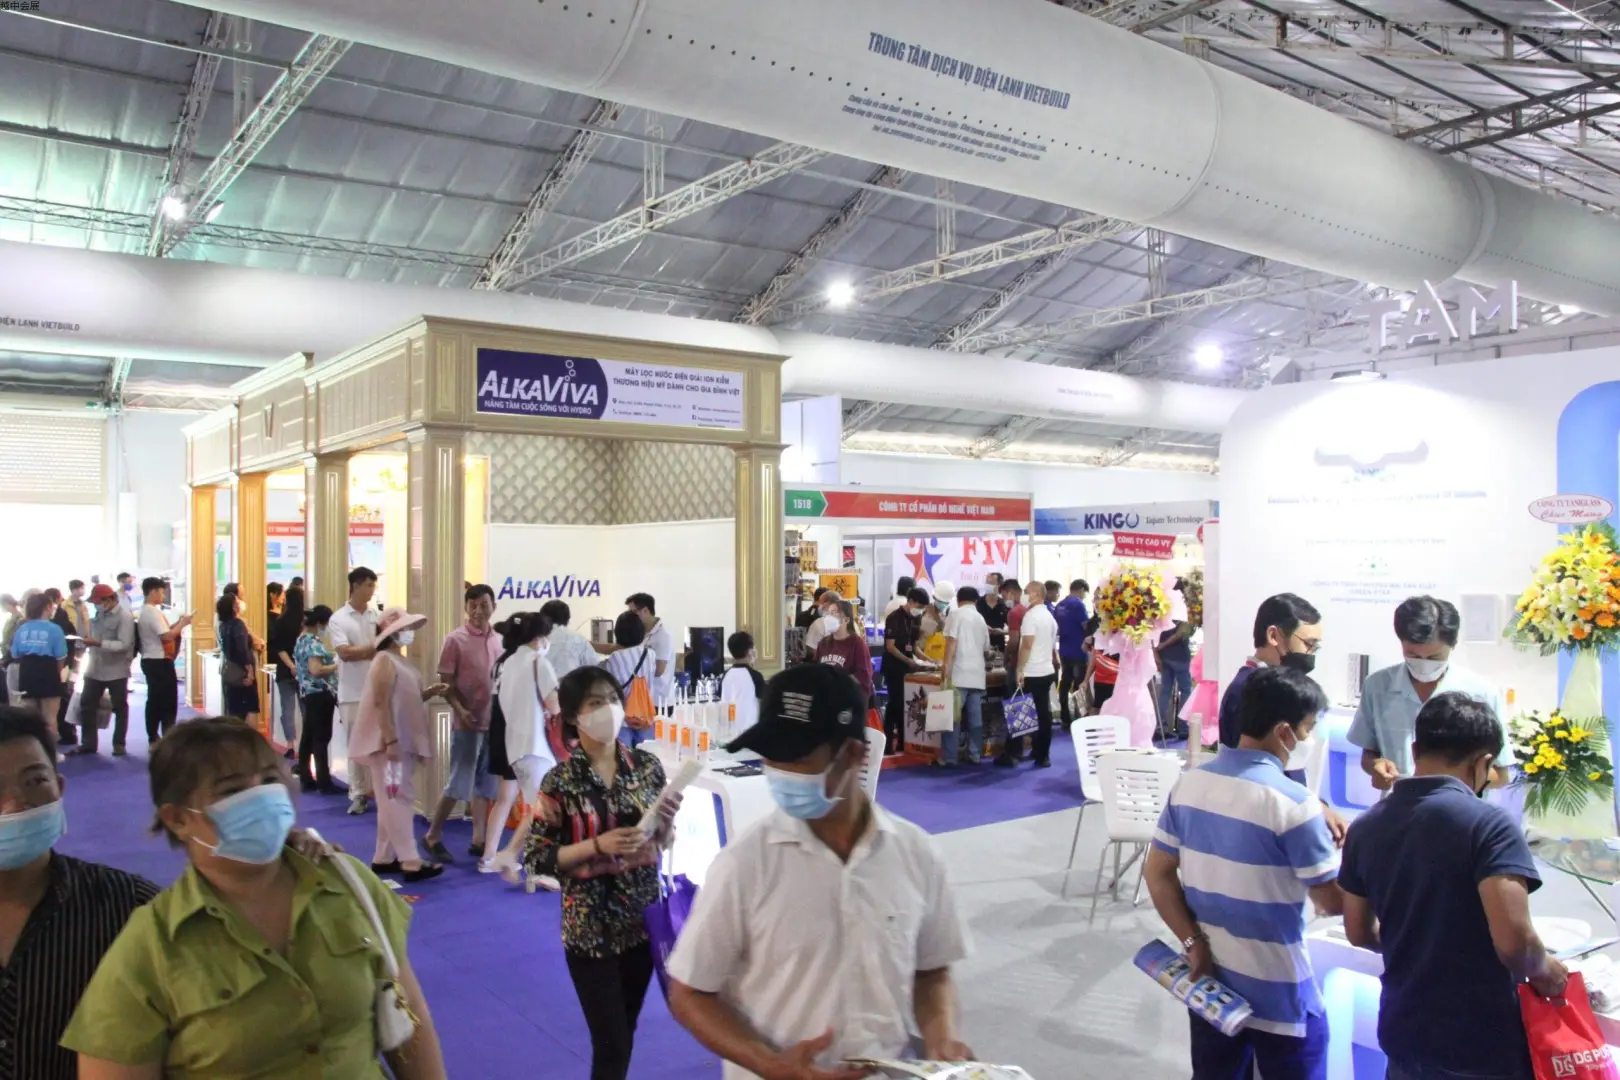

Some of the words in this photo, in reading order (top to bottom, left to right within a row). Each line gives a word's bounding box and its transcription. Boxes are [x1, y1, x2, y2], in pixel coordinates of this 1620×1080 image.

[868, 32, 906, 61] TRUNG
[907, 44, 931, 69] TÂM
[931, 53, 959, 77] DỊCH
[958, 62, 974, 86] VỤ
[973, 67, 998, 92] ĐIỆN
[998, 75, 1024, 98] LẠNH
[1023, 82, 1071, 110] VIETBUILD
[41, 320, 80, 331] VIETBUILD
[625, 367, 639, 375] MÁY
[640, 370, 653, 378] LỌC
[655, 370, 673, 379] NƯỚC
[674, 372, 688, 381] ĐIỆN
[689, 373, 702, 382] GIẢI
[703, 376, 715, 384] ION
[613, 378, 639, 387] THƯƠNG
[641, 380, 655, 389] HIỆU
[667, 382, 684, 391] DÀNH
[700, 386, 711, 394] GIA
[712, 386, 728, 395] ĐÌNH
[728, 388, 740, 397] VIỆT
[521, 401, 539, 412] CUỘC
[540, 402, 557, 413] SỐNG
[558, 404, 570, 413] VỚI
[570, 406, 592, 415] HYDRO
[879, 501, 898, 512] CÔNG
[899, 502, 908, 512] TY
[908, 500, 919, 513] CỔ
[966, 504, 980, 516] VIỆT
[980, 506, 995, 515] NAM
[1146, 516, 1164, 526] Japan
[1166, 515, 1204, 525] Technology
[1117, 536, 1134, 545] CÔNG
[1135, 537, 1144, 545] TY
[1145, 538, 1160, 546] CAO
[1573, 1050, 1593, 1065] DG
